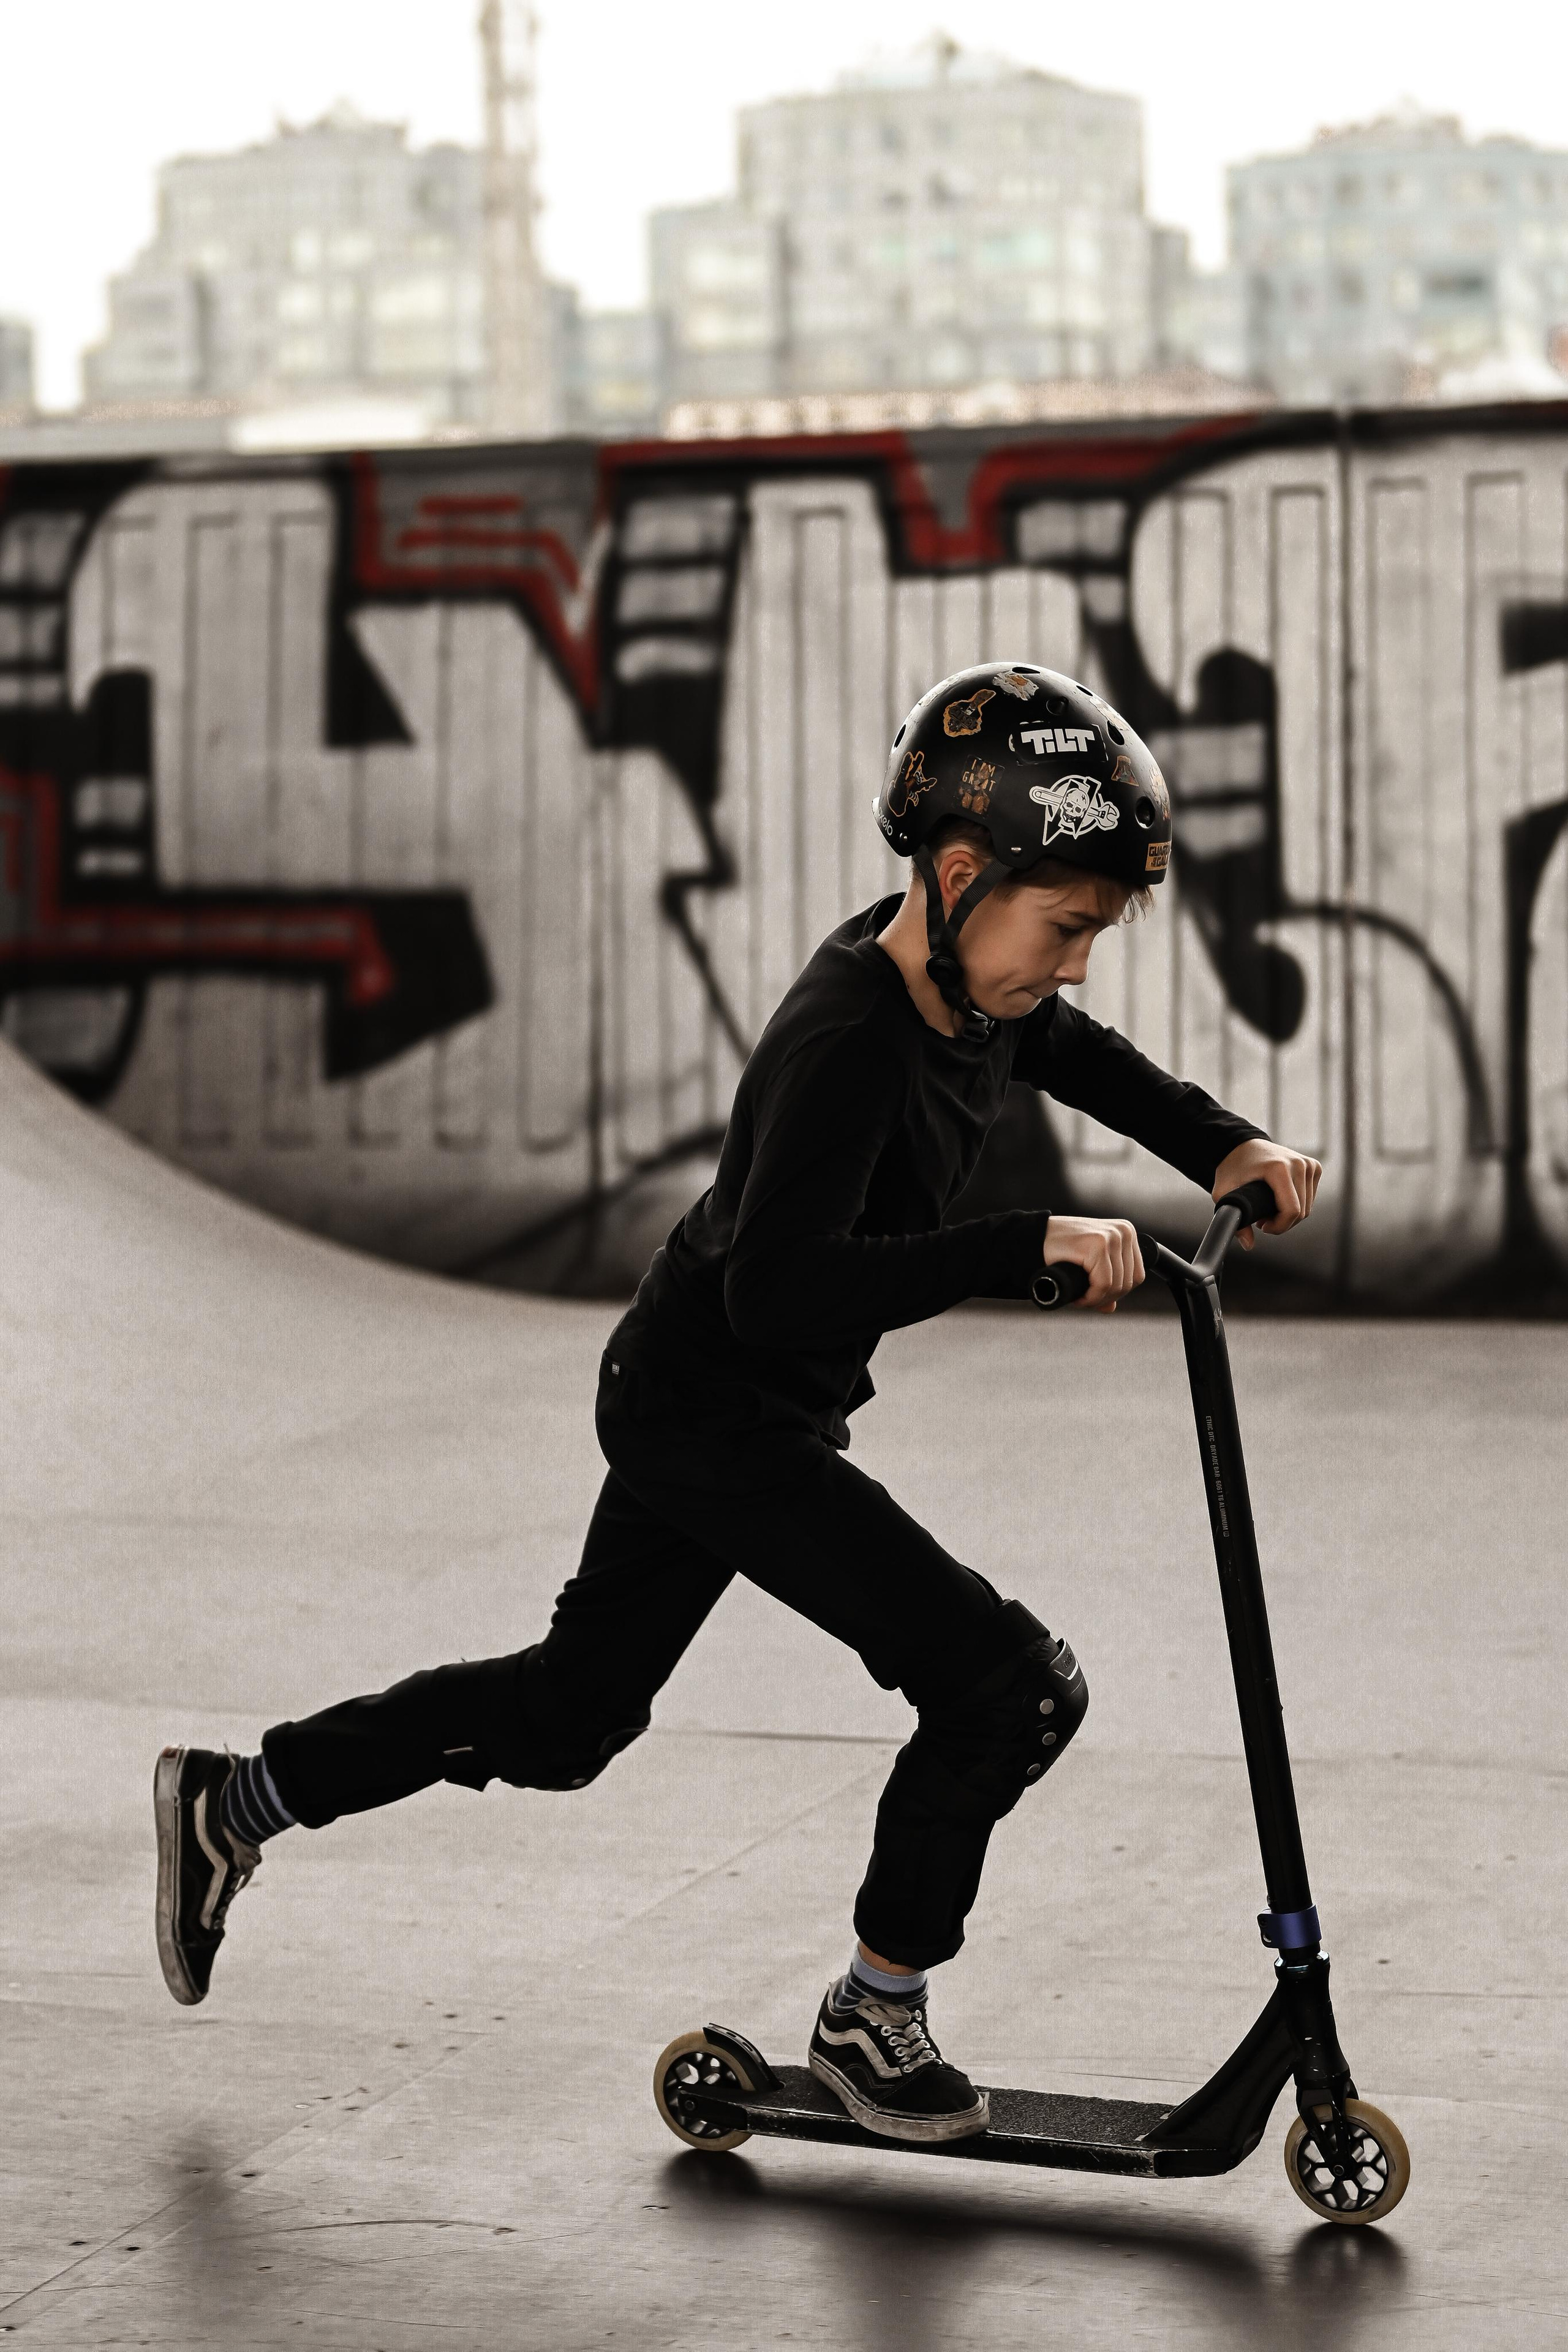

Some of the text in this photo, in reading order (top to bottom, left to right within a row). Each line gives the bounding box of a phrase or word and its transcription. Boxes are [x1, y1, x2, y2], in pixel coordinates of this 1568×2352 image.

[1020, 728, 1095, 755] TILT
[962, 771, 996, 791] GRAT
[1210, 1445, 1218, 1466] DRYADE
